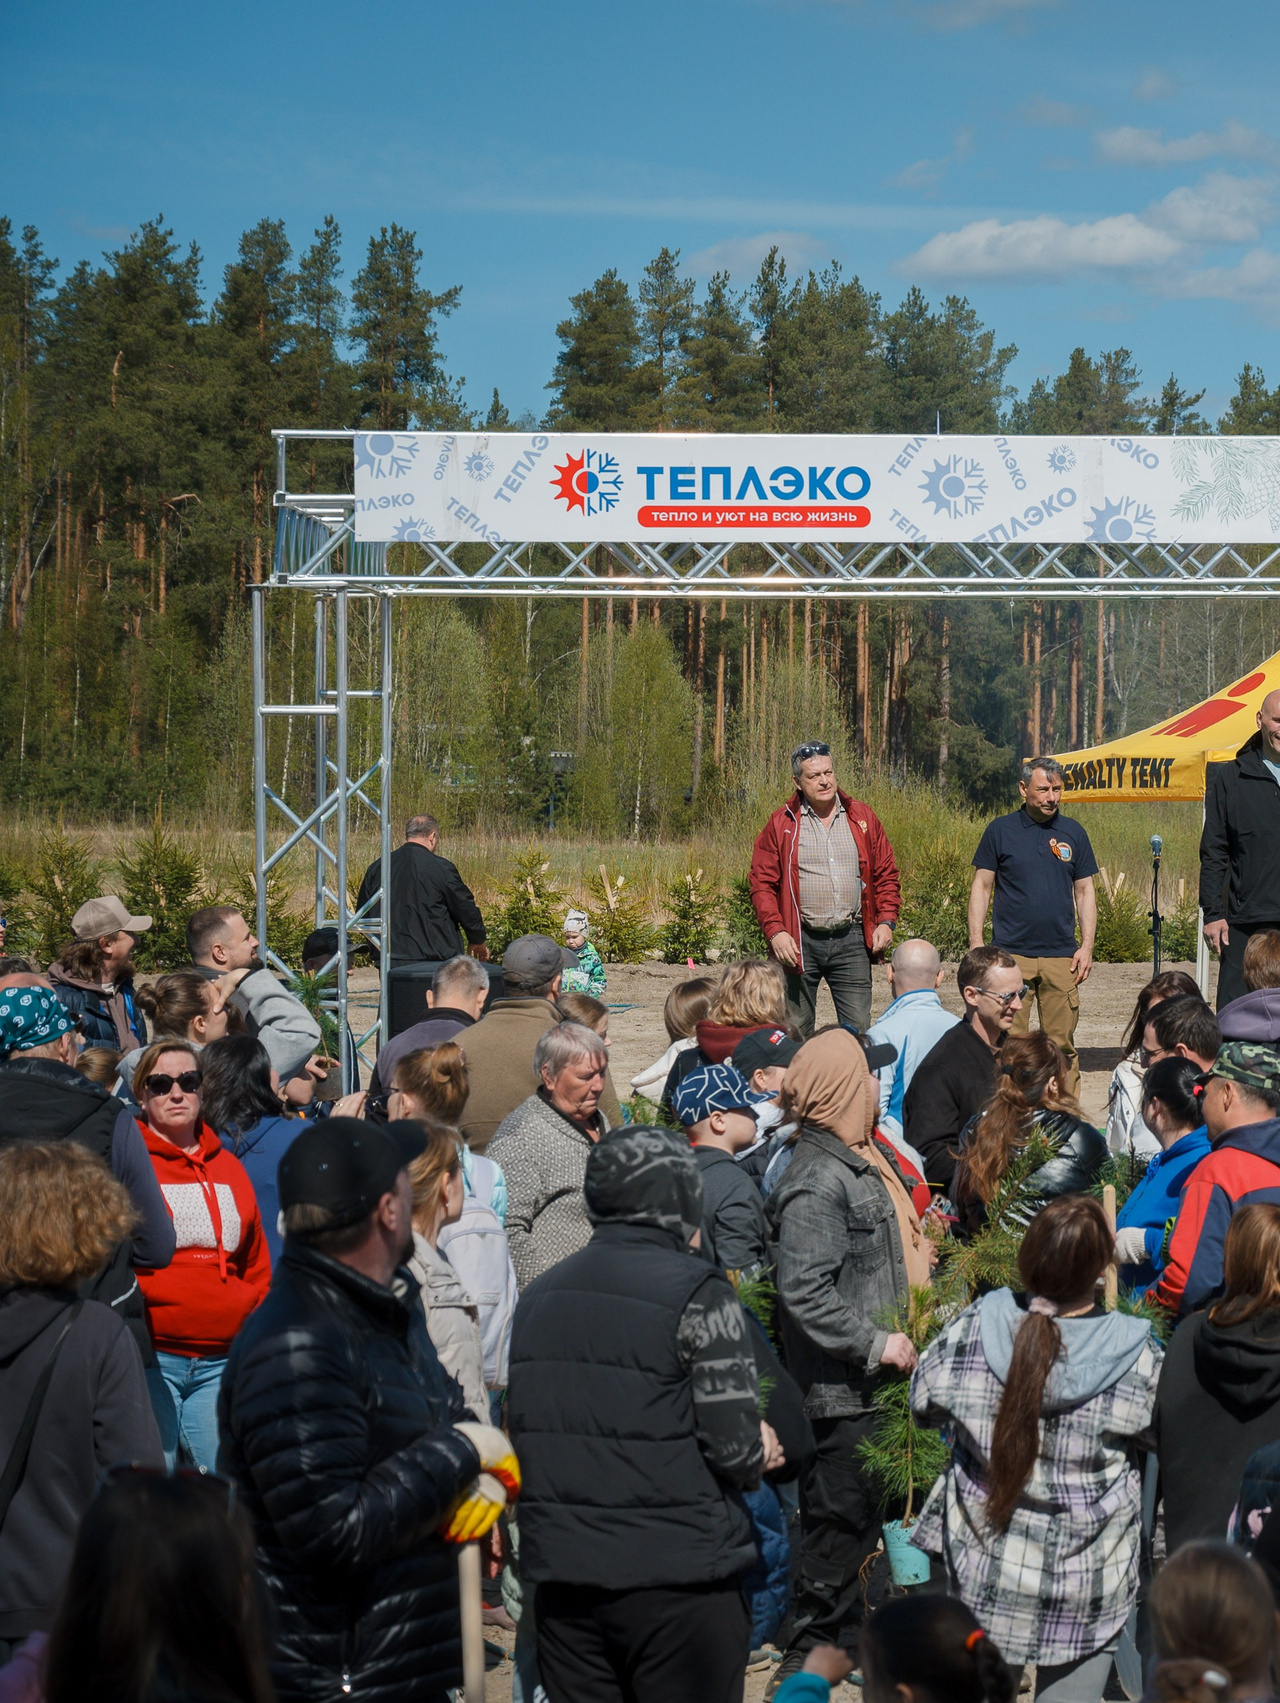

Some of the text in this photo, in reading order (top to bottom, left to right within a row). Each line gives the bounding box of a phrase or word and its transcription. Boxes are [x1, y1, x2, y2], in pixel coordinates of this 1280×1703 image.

[636, 466, 872, 501] ТЕПЛЭКО
[446, 496, 508, 542] ТЕПЛЭ
[651, 510, 858, 525] тепло и уют на всю жизнь
[1060, 757, 1176, 791] ENALTY TENT
